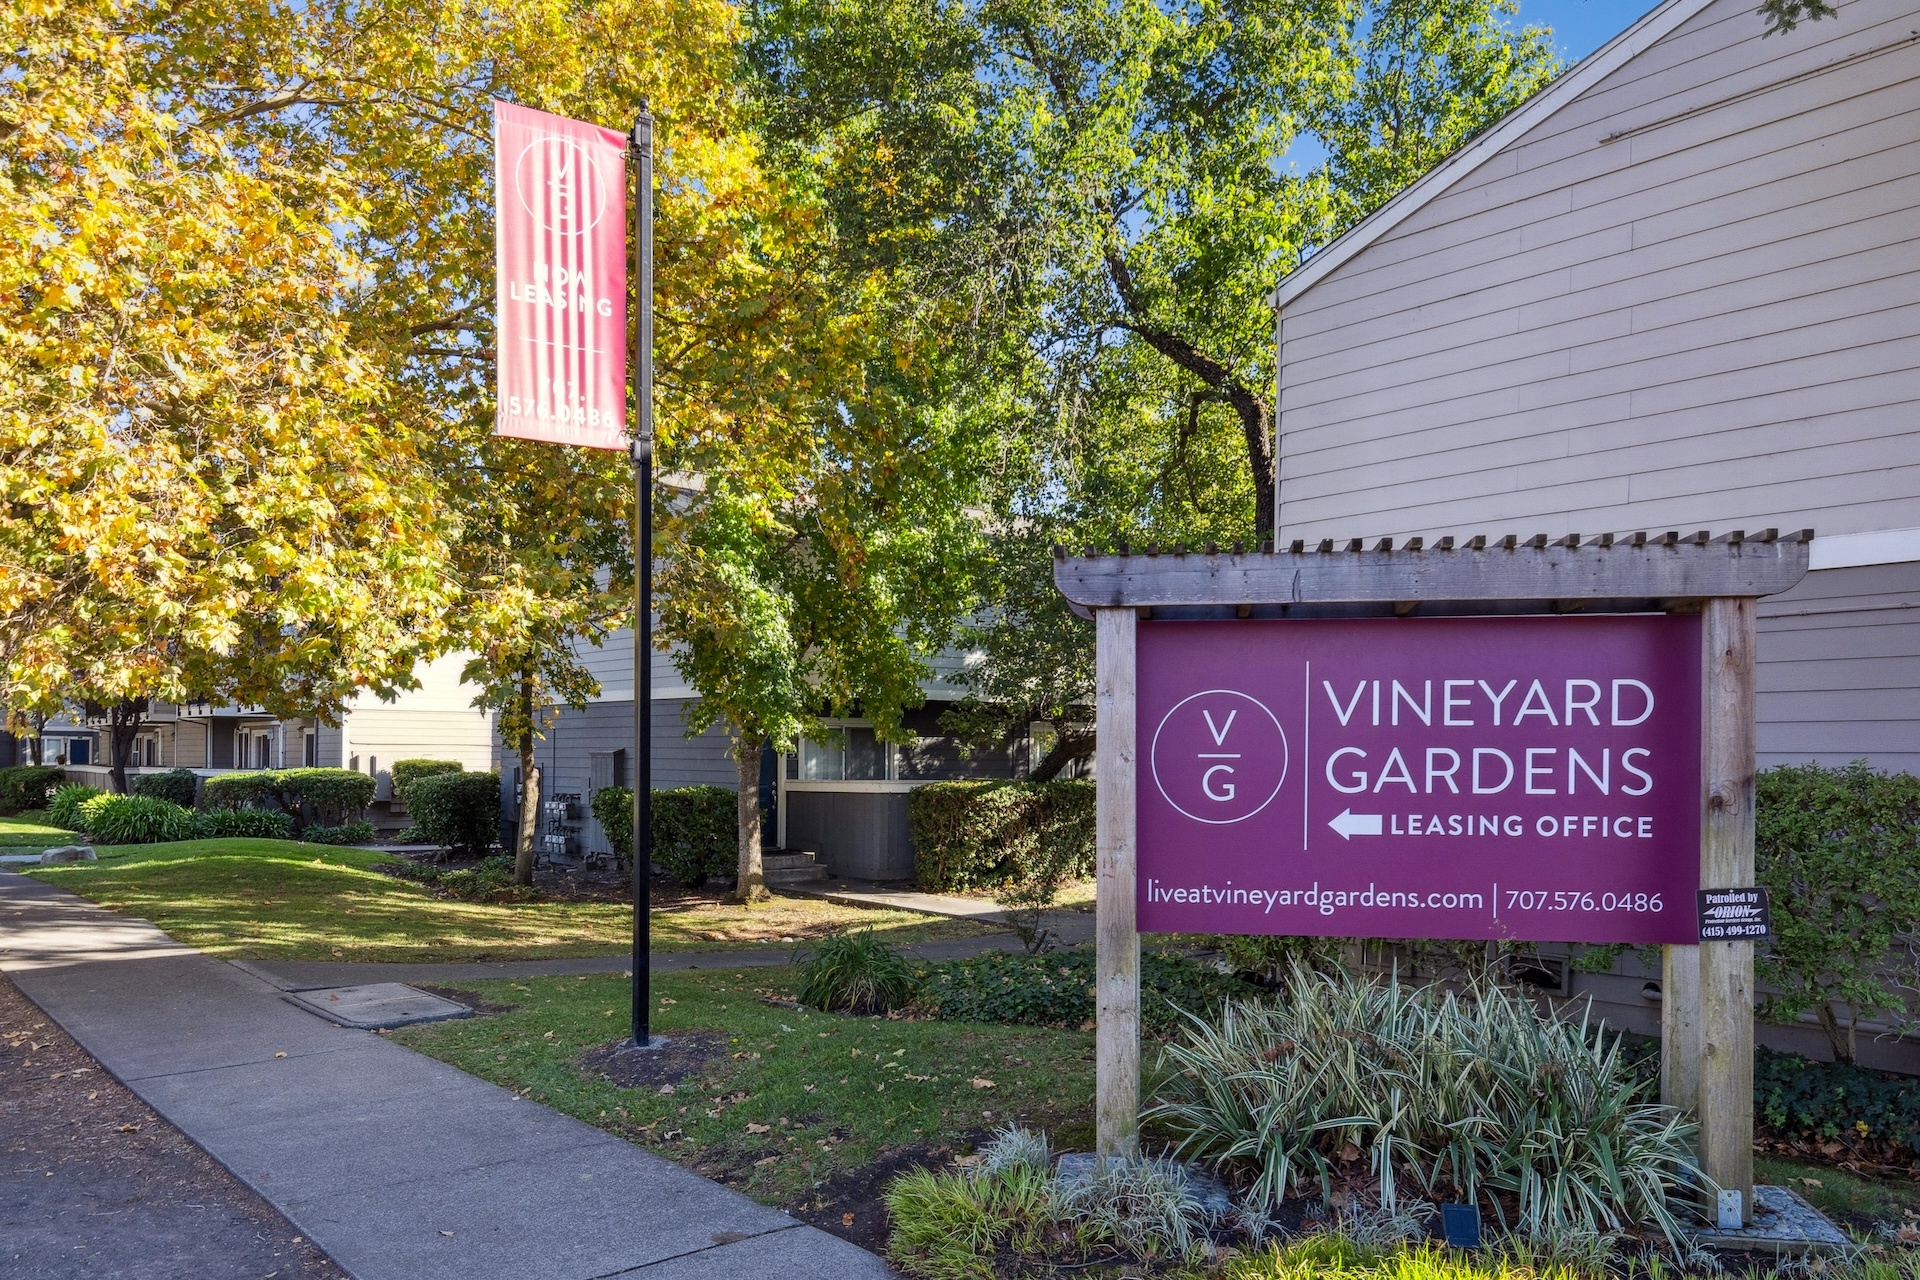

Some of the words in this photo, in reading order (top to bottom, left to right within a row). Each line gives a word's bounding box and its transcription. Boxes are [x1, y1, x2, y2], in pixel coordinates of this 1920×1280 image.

[510, 280, 613, 317] LEASNG
[1322, 678, 1655, 727] VINEYARD
[1202, 709, 1238, 747] V
[1202, 764, 1236, 802] G
[1325, 746, 1654, 796] GARDENS
[1390, 814, 1523, 837] LEASING
[1535, 815, 1653, 838] OFFICE
[1147, 878, 1483, 916] liveatvineyardgardens.com
[1505, 889, 1664, 914] 707.576.0486
[1706, 893, 1746, 904] Patrolled
[1747, 892, 1758, 903] by
[1714, 905, 1752, 918] ORION
[1702, 926, 1724, 937] (415)
[1726, 924, 1766, 936] 499-1270
